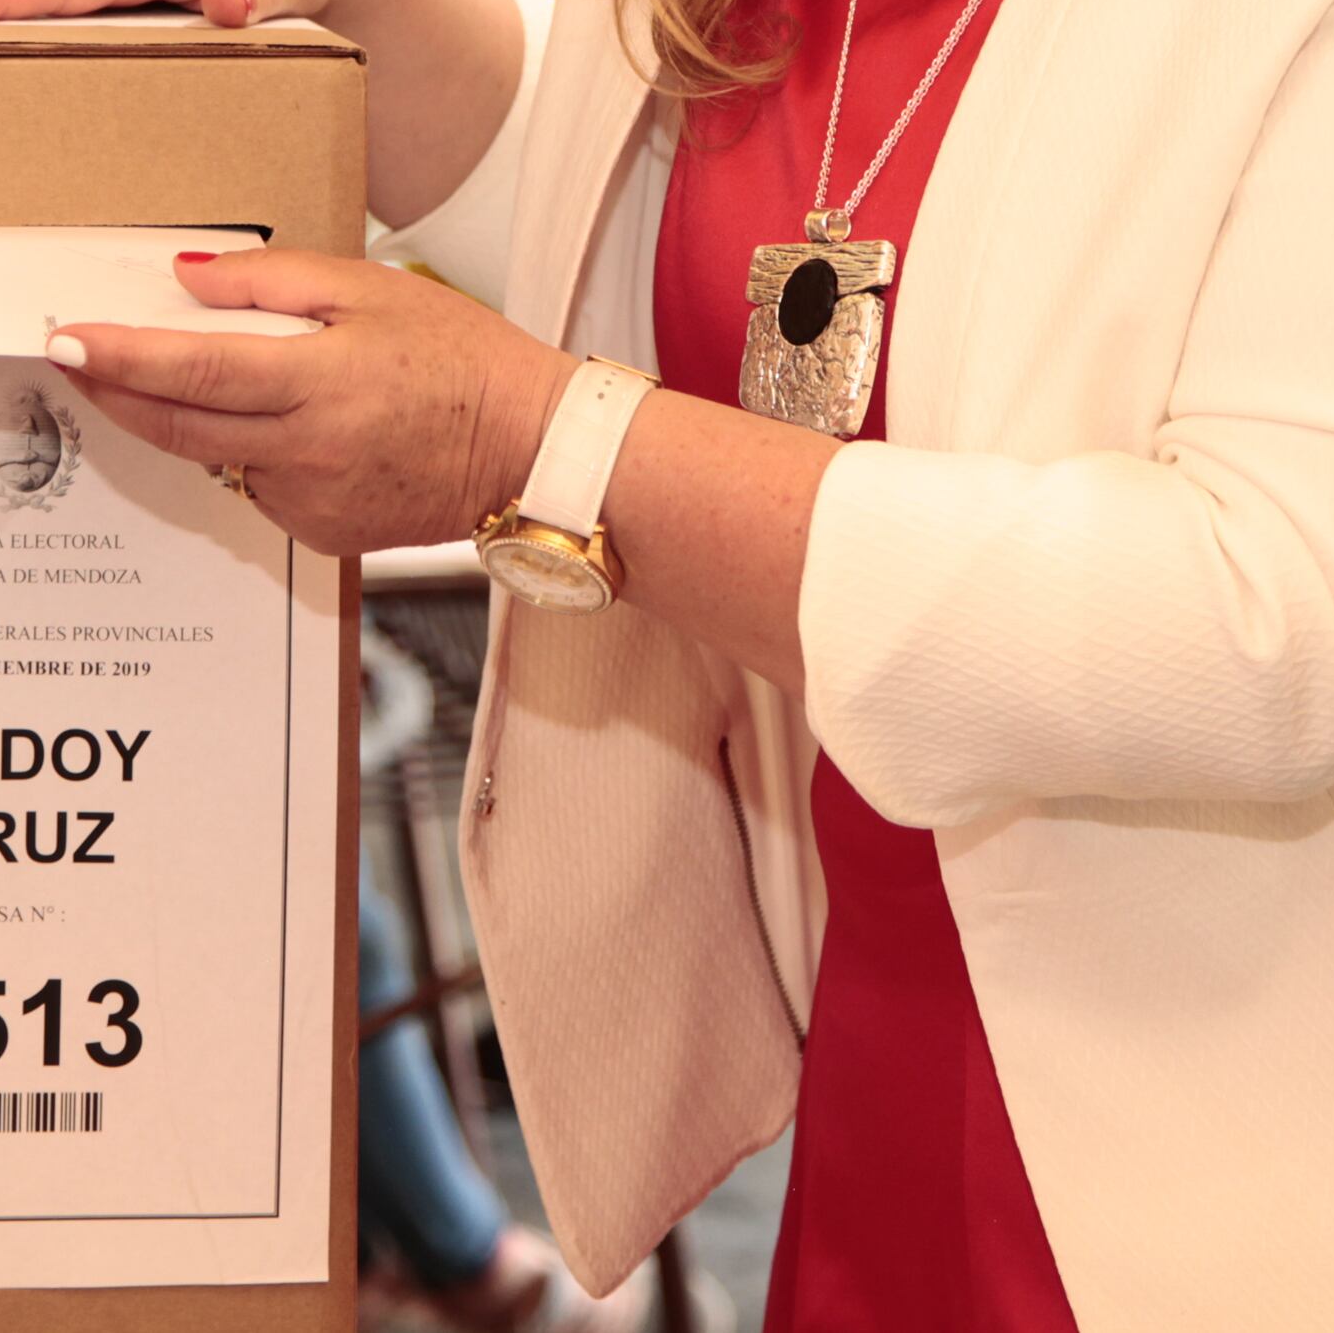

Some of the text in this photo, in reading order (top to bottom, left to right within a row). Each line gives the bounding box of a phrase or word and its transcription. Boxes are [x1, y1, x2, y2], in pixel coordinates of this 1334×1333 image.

[10, 533, 125, 550] ELECTORAL
[13, 568, 38, 584] DE
[44, 568, 142, 585] MENDOZA
[72, 625, 214, 643] PROVINCIALES
[80, 660, 107, 677] DE
[111, 660, 152, 677] 2019
